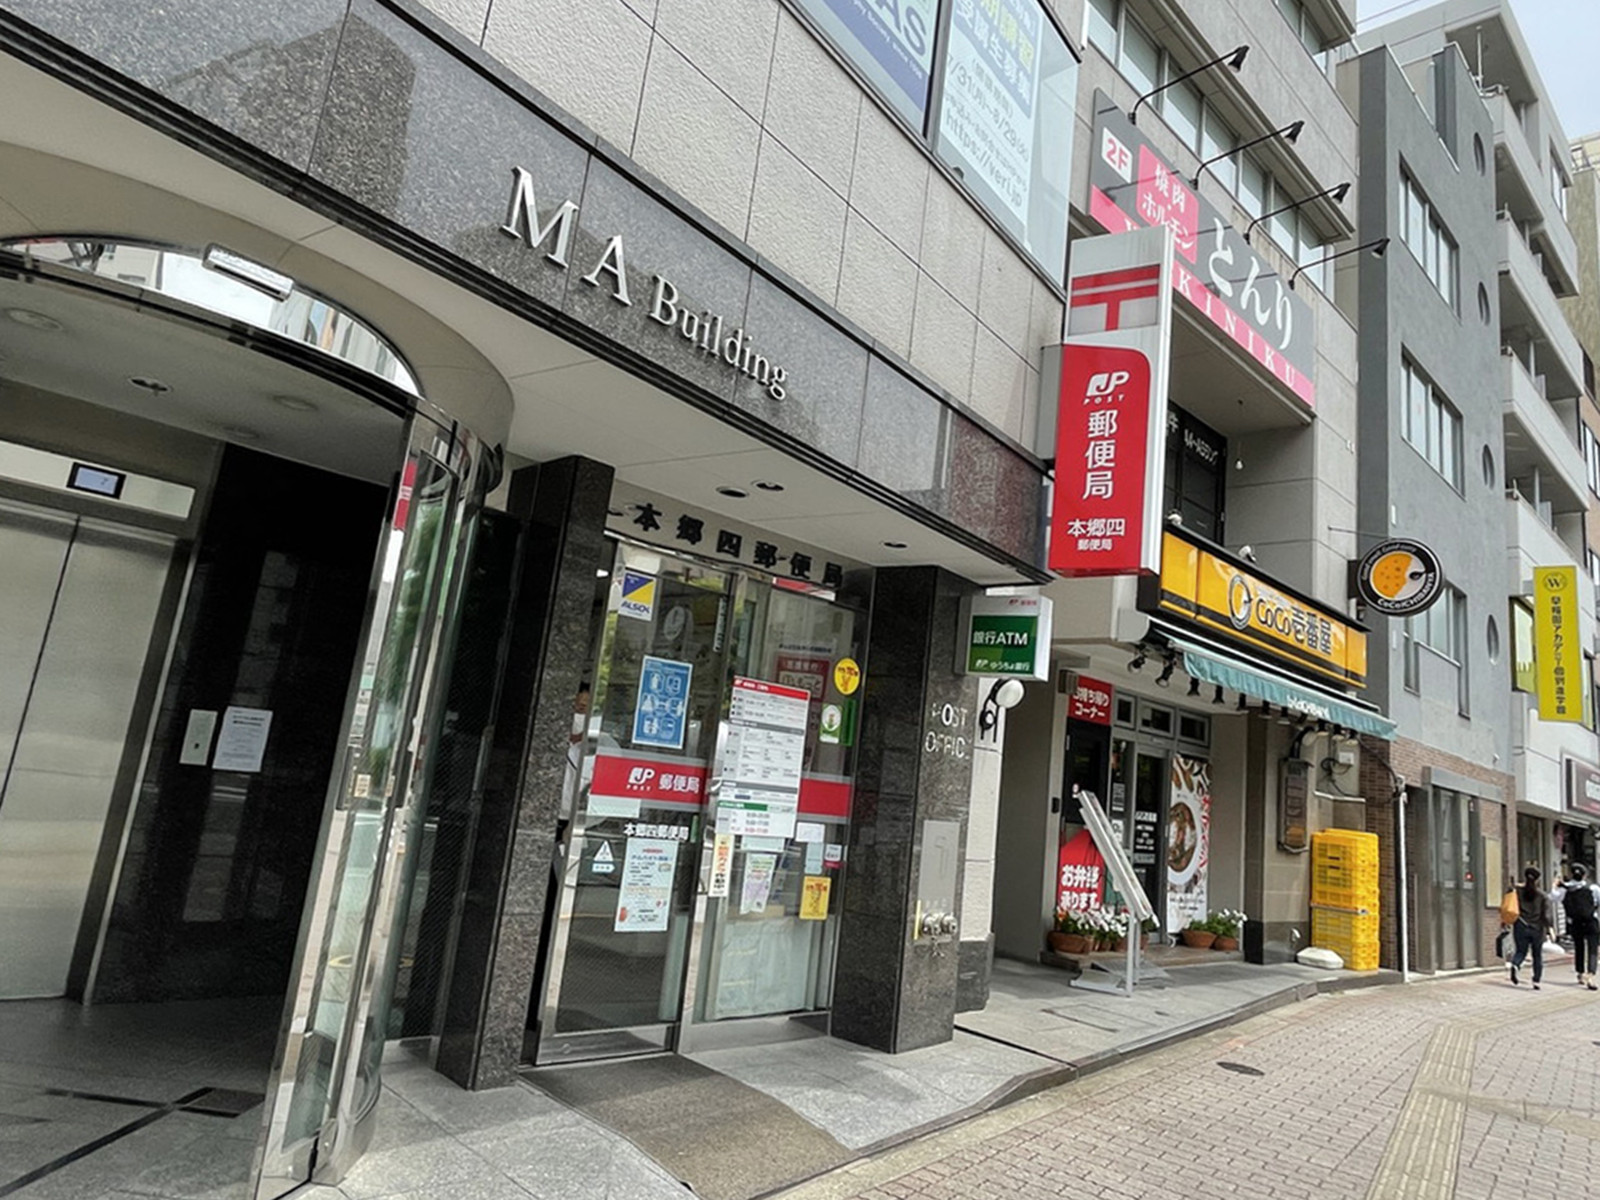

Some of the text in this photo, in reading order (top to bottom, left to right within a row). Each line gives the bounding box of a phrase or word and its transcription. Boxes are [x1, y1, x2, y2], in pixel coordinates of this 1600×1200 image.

[1105, 137, 1129, 170] 2F
[1142, 191, 1194, 250] ホルモン
[1208, 217, 1293, 350] とんり
[648, 273, 789, 401] Building
[1083, 394, 1125, 406] POST
[1082, 409, 1119, 501] 郵便局
[1066, 517, 1126, 538] 本郷四
[632, 502, 843, 589] 本郷四郵便局
[1076, 538, 1113, 551] 郵便局
[621, 600, 651, 614] ALSOK
[973, 630, 1029, 646] 銀行ATM
[1074, 702, 1106, 719] コーナー
[658, 772, 700, 795] 郵便局
[623, 821, 690, 842] 本郷四郵便局
[1061, 864, 1100, 889] お弁当
